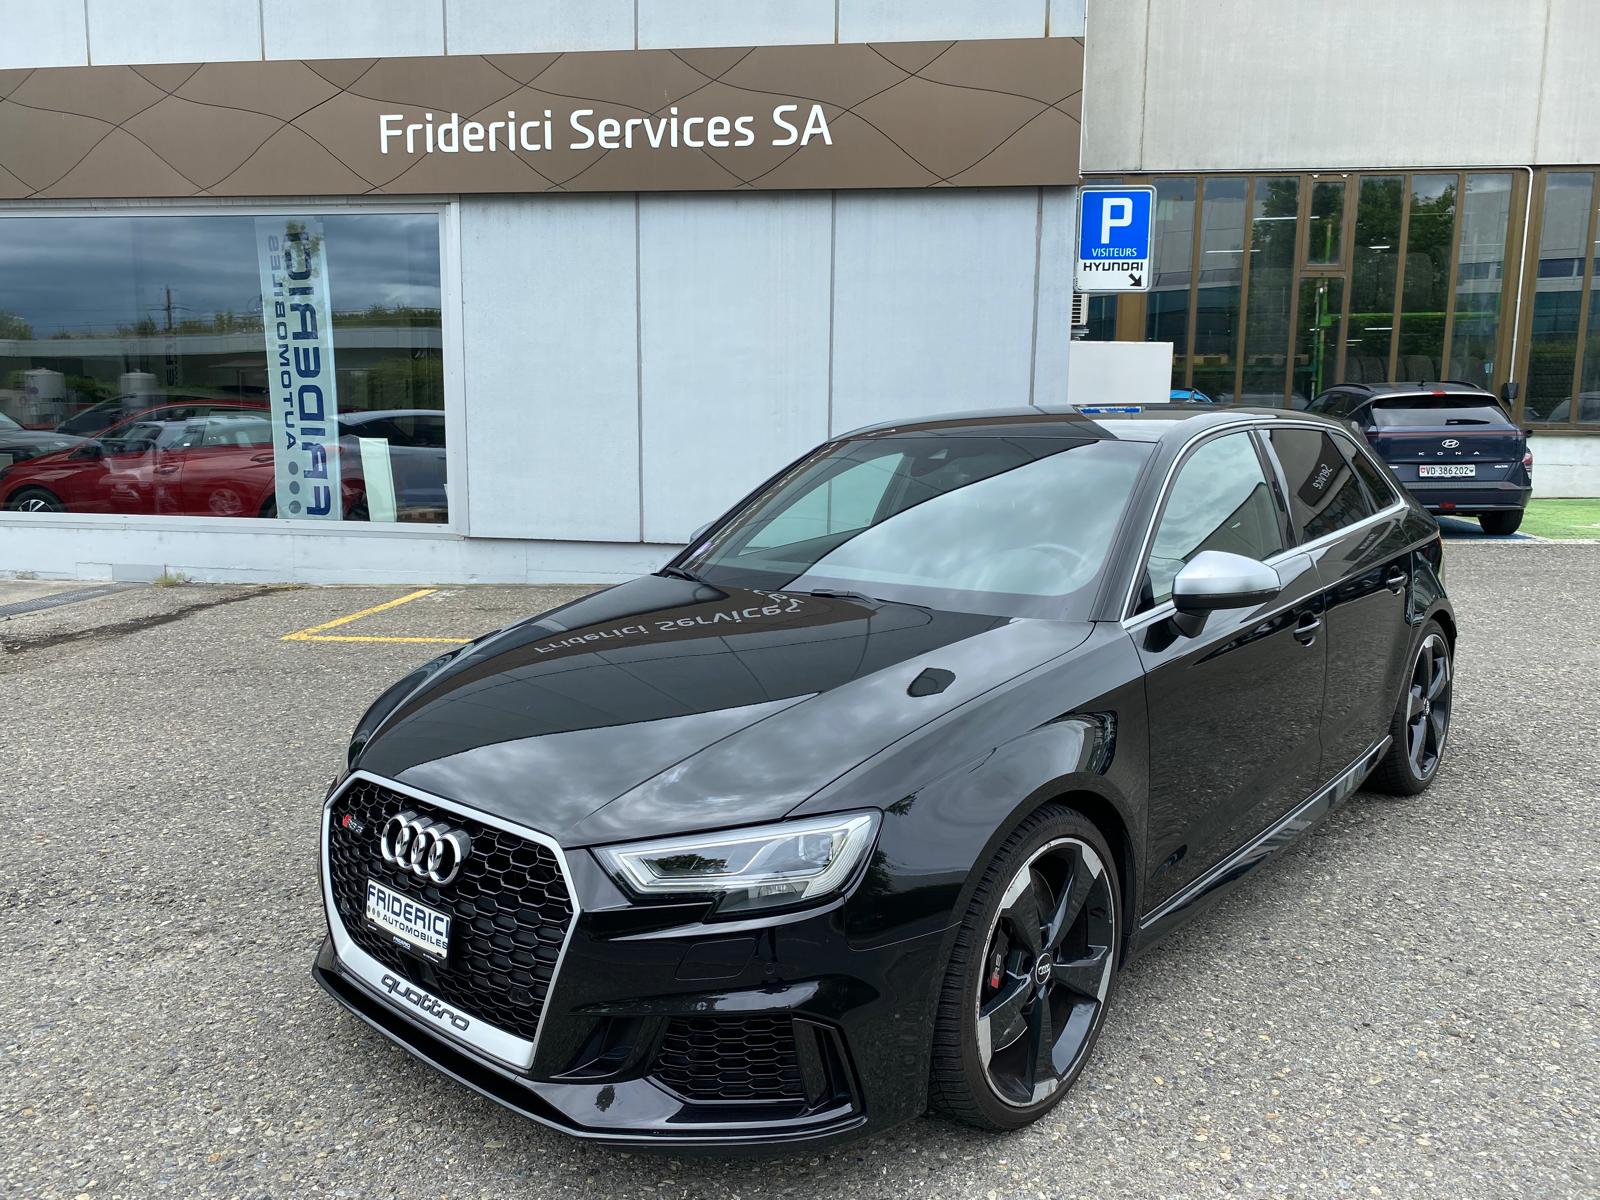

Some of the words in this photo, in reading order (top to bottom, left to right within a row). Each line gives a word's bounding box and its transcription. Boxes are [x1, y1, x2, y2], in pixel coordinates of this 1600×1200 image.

[379, 109, 552, 154] Friderici
[569, 106, 755, 150] Services
[771, 104, 834, 147] SA
[1101, 197, 1133, 244] P
[1083, 262, 1143, 271] HYUNDAI
[1091, 247, 1137, 257] VISITEURS
[368, 884, 450, 939] FRIDERICI
[382, 914, 449, 950] AUTOMOBILES
[380, 973, 470, 1032] quattro
